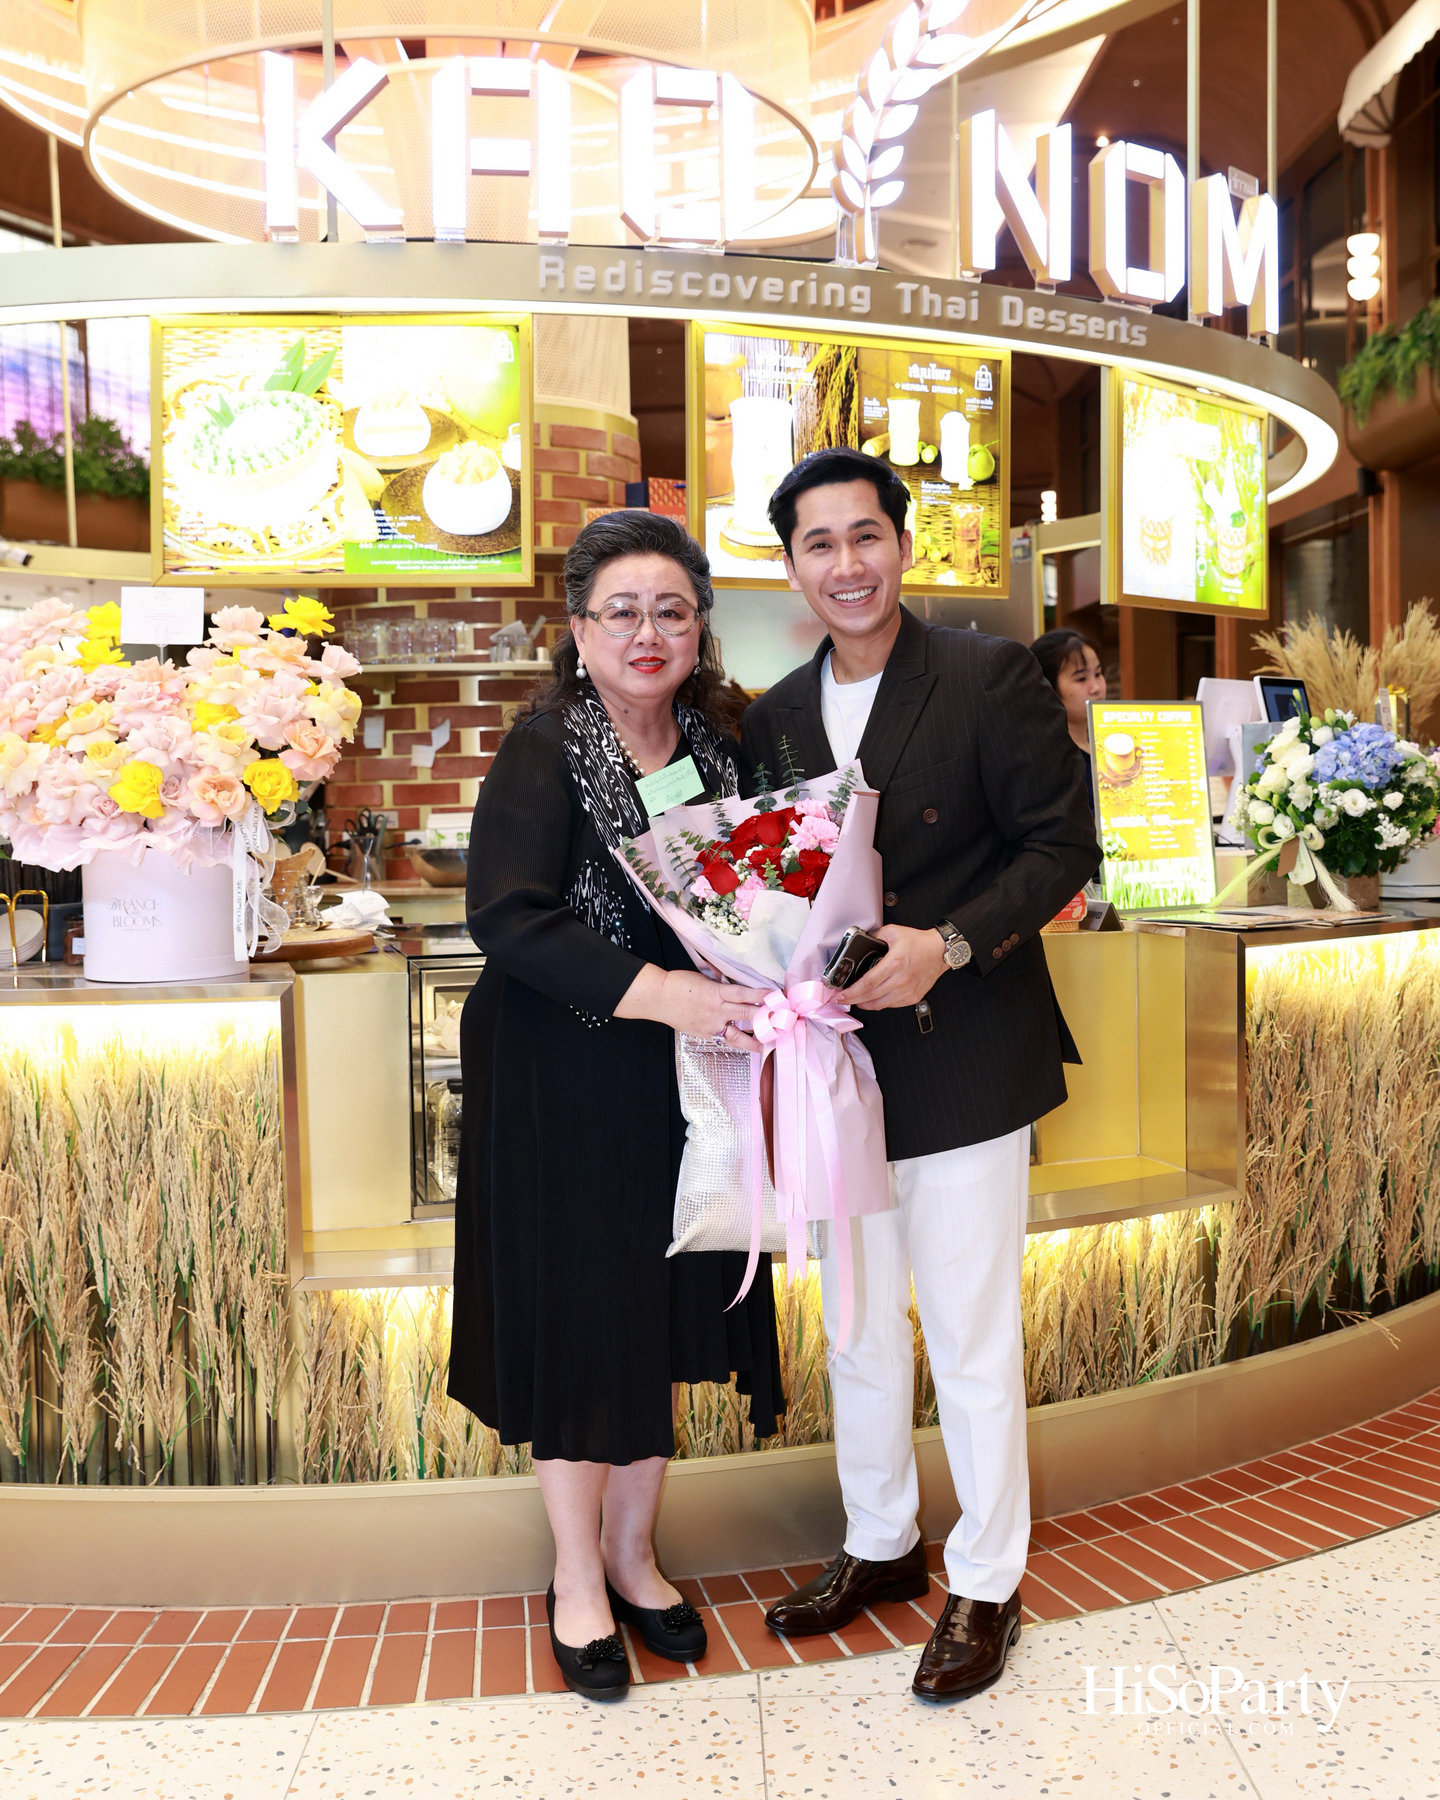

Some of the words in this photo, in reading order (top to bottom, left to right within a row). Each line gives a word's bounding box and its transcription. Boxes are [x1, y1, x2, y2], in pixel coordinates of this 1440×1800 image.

[960, 108, 1279, 334] NOM
[539, 255, 871, 313] Rediscovering
[896, 282, 979, 322] Thai
[1001, 294, 1147, 347] Desserts
[1103, 711, 1154, 722] SPECIALTY
[1157, 711, 1192, 722] COFFEE
[112, 915, 163, 928] BLOOMS
